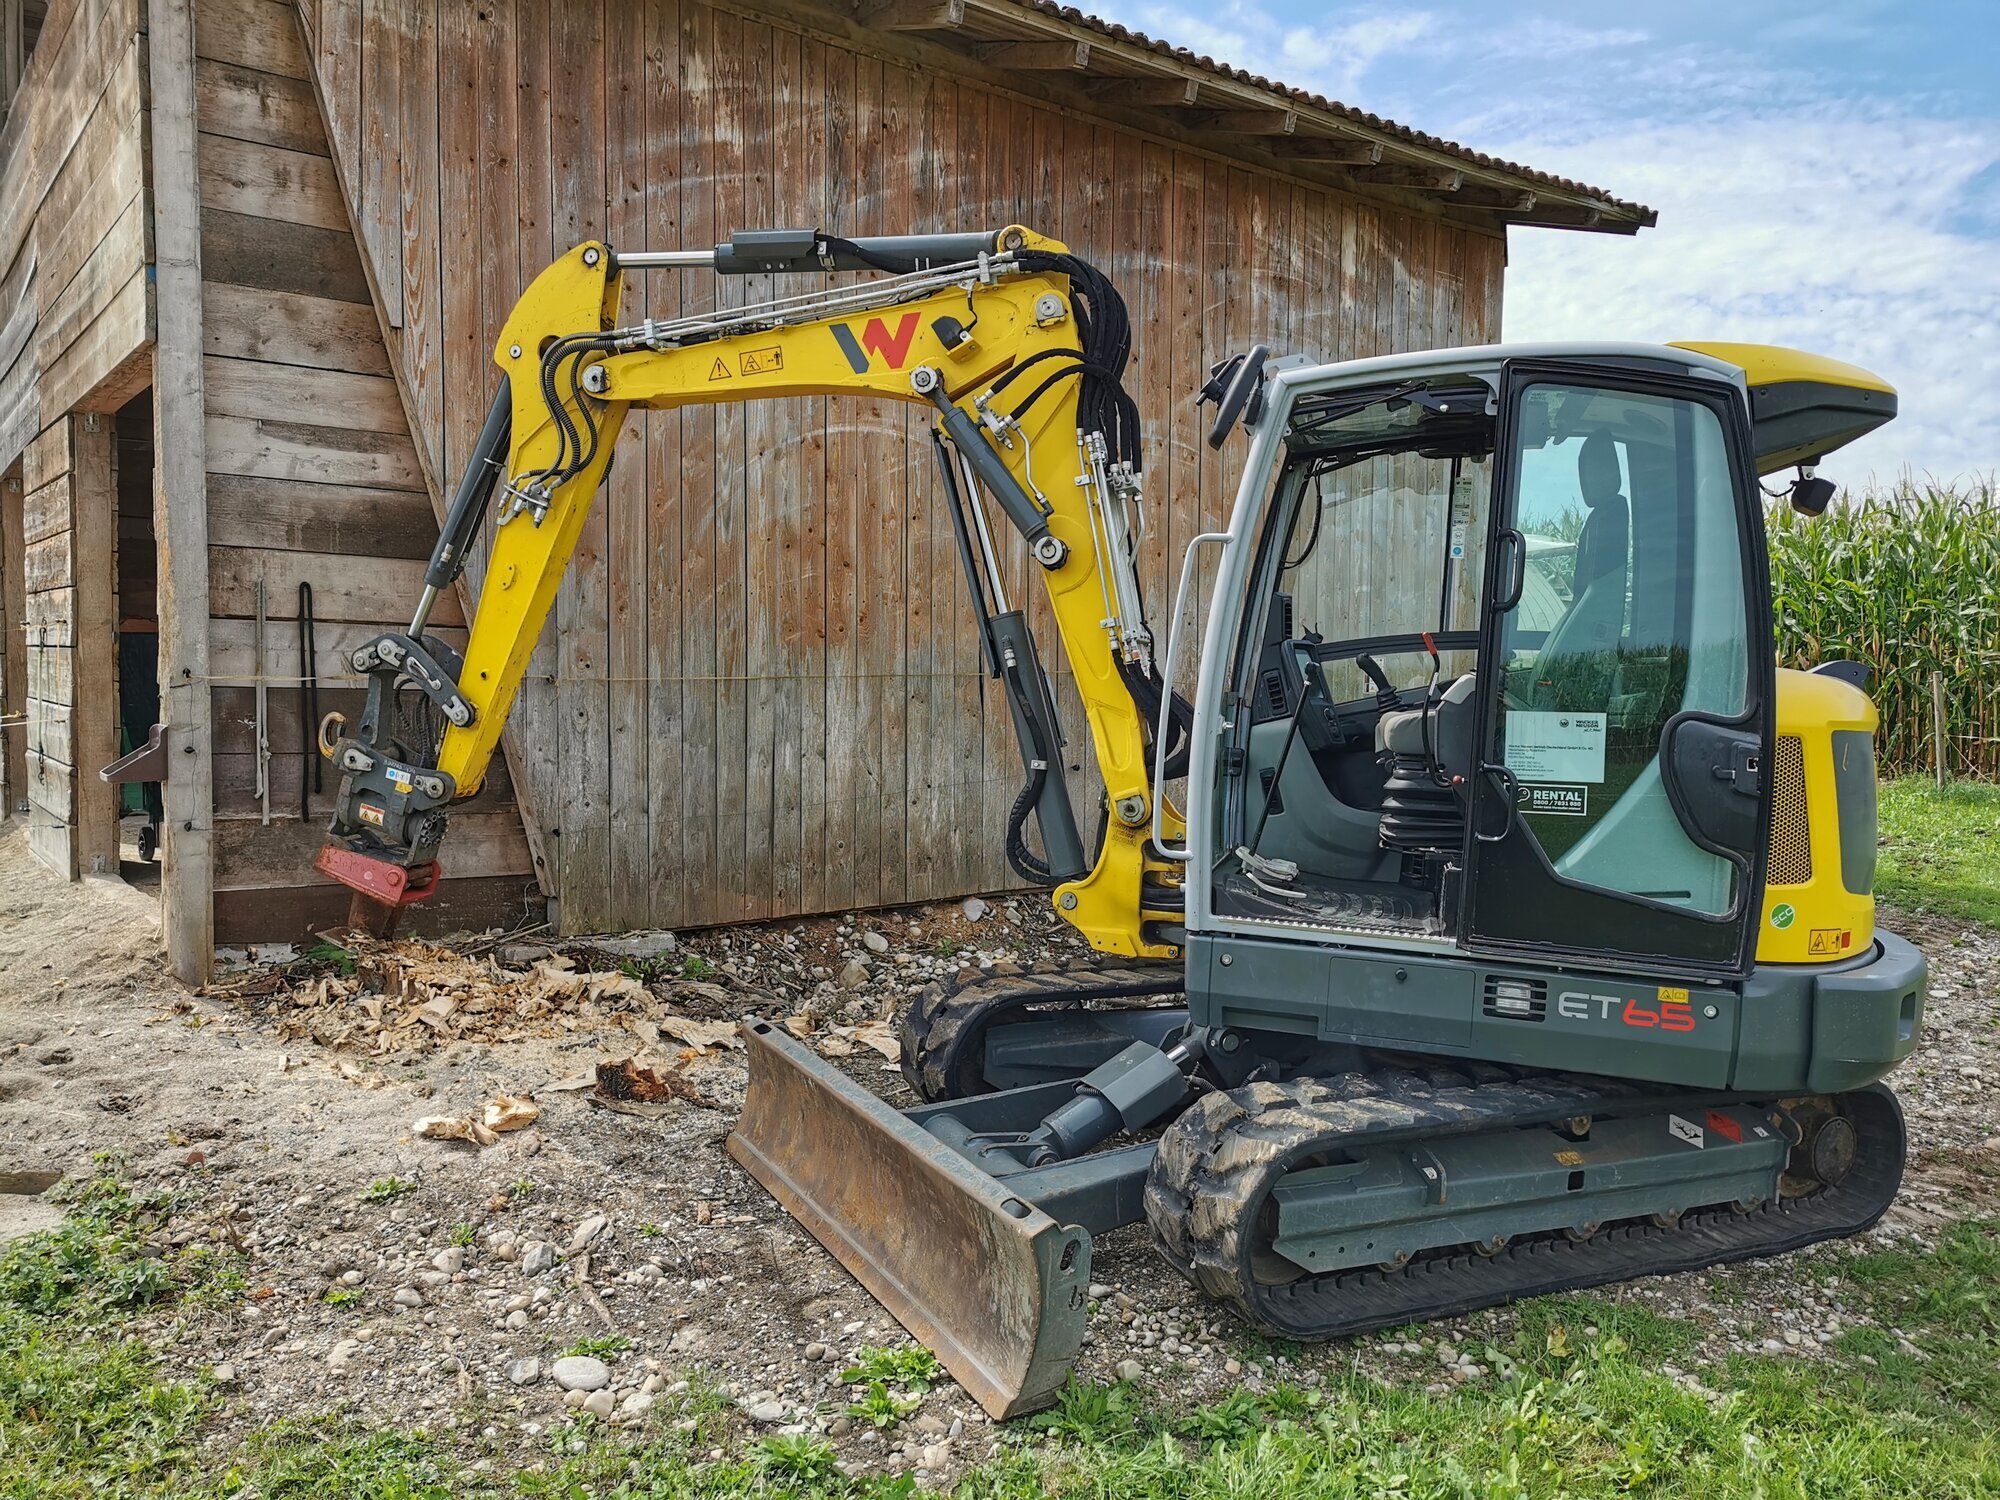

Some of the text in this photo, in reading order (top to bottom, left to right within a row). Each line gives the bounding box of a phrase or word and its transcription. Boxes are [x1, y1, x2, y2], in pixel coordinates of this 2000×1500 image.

[1533, 790, 1582, 801] RENTAL
[1772, 905, 1794, 926] ECO
[1558, 991, 1695, 1031] ET65
